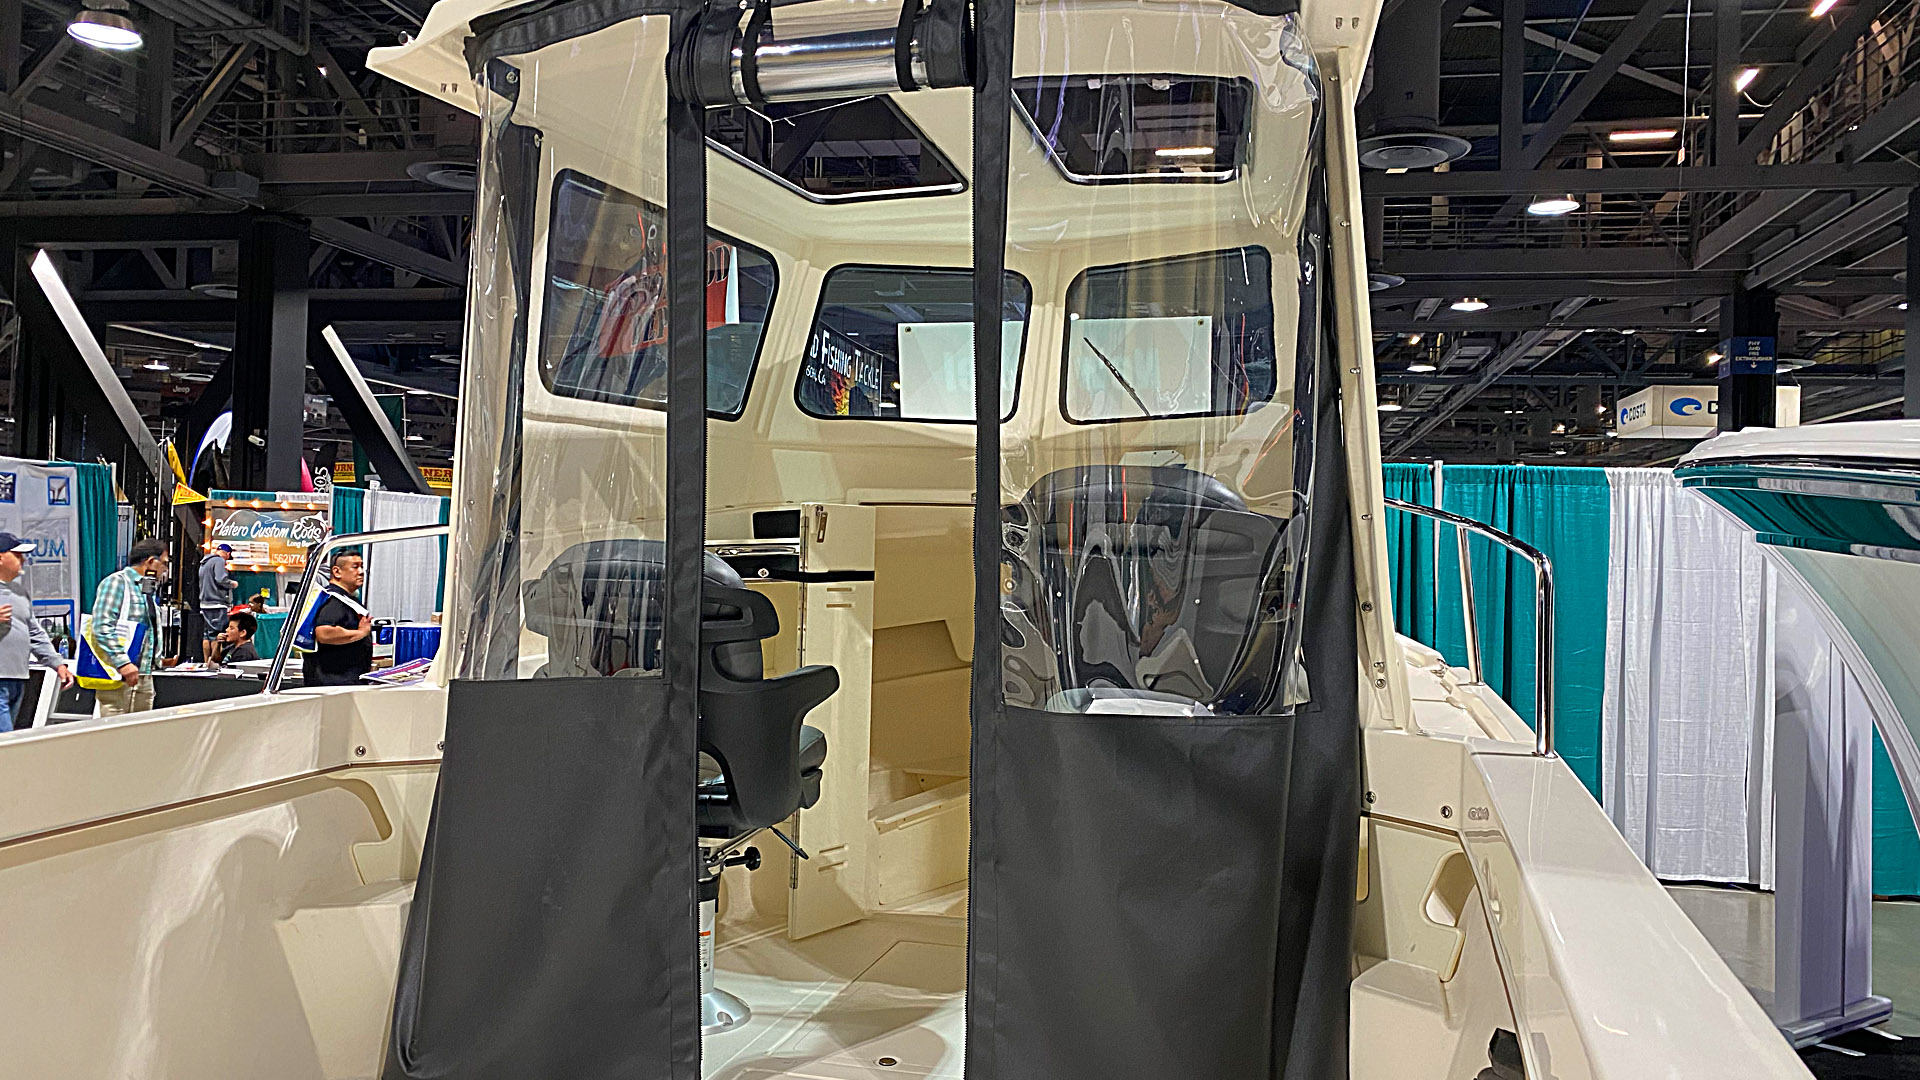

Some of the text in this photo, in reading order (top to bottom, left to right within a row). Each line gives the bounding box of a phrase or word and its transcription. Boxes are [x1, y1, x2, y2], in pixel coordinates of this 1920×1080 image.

[854, 349, 880, 390] TACKLE
[172, 385, 190, 394] Jeep
[1628, 402, 1647, 421] COSTA
[211, 518, 322, 540] Platero Custom Rods
[286, 539, 301, 548] Long
